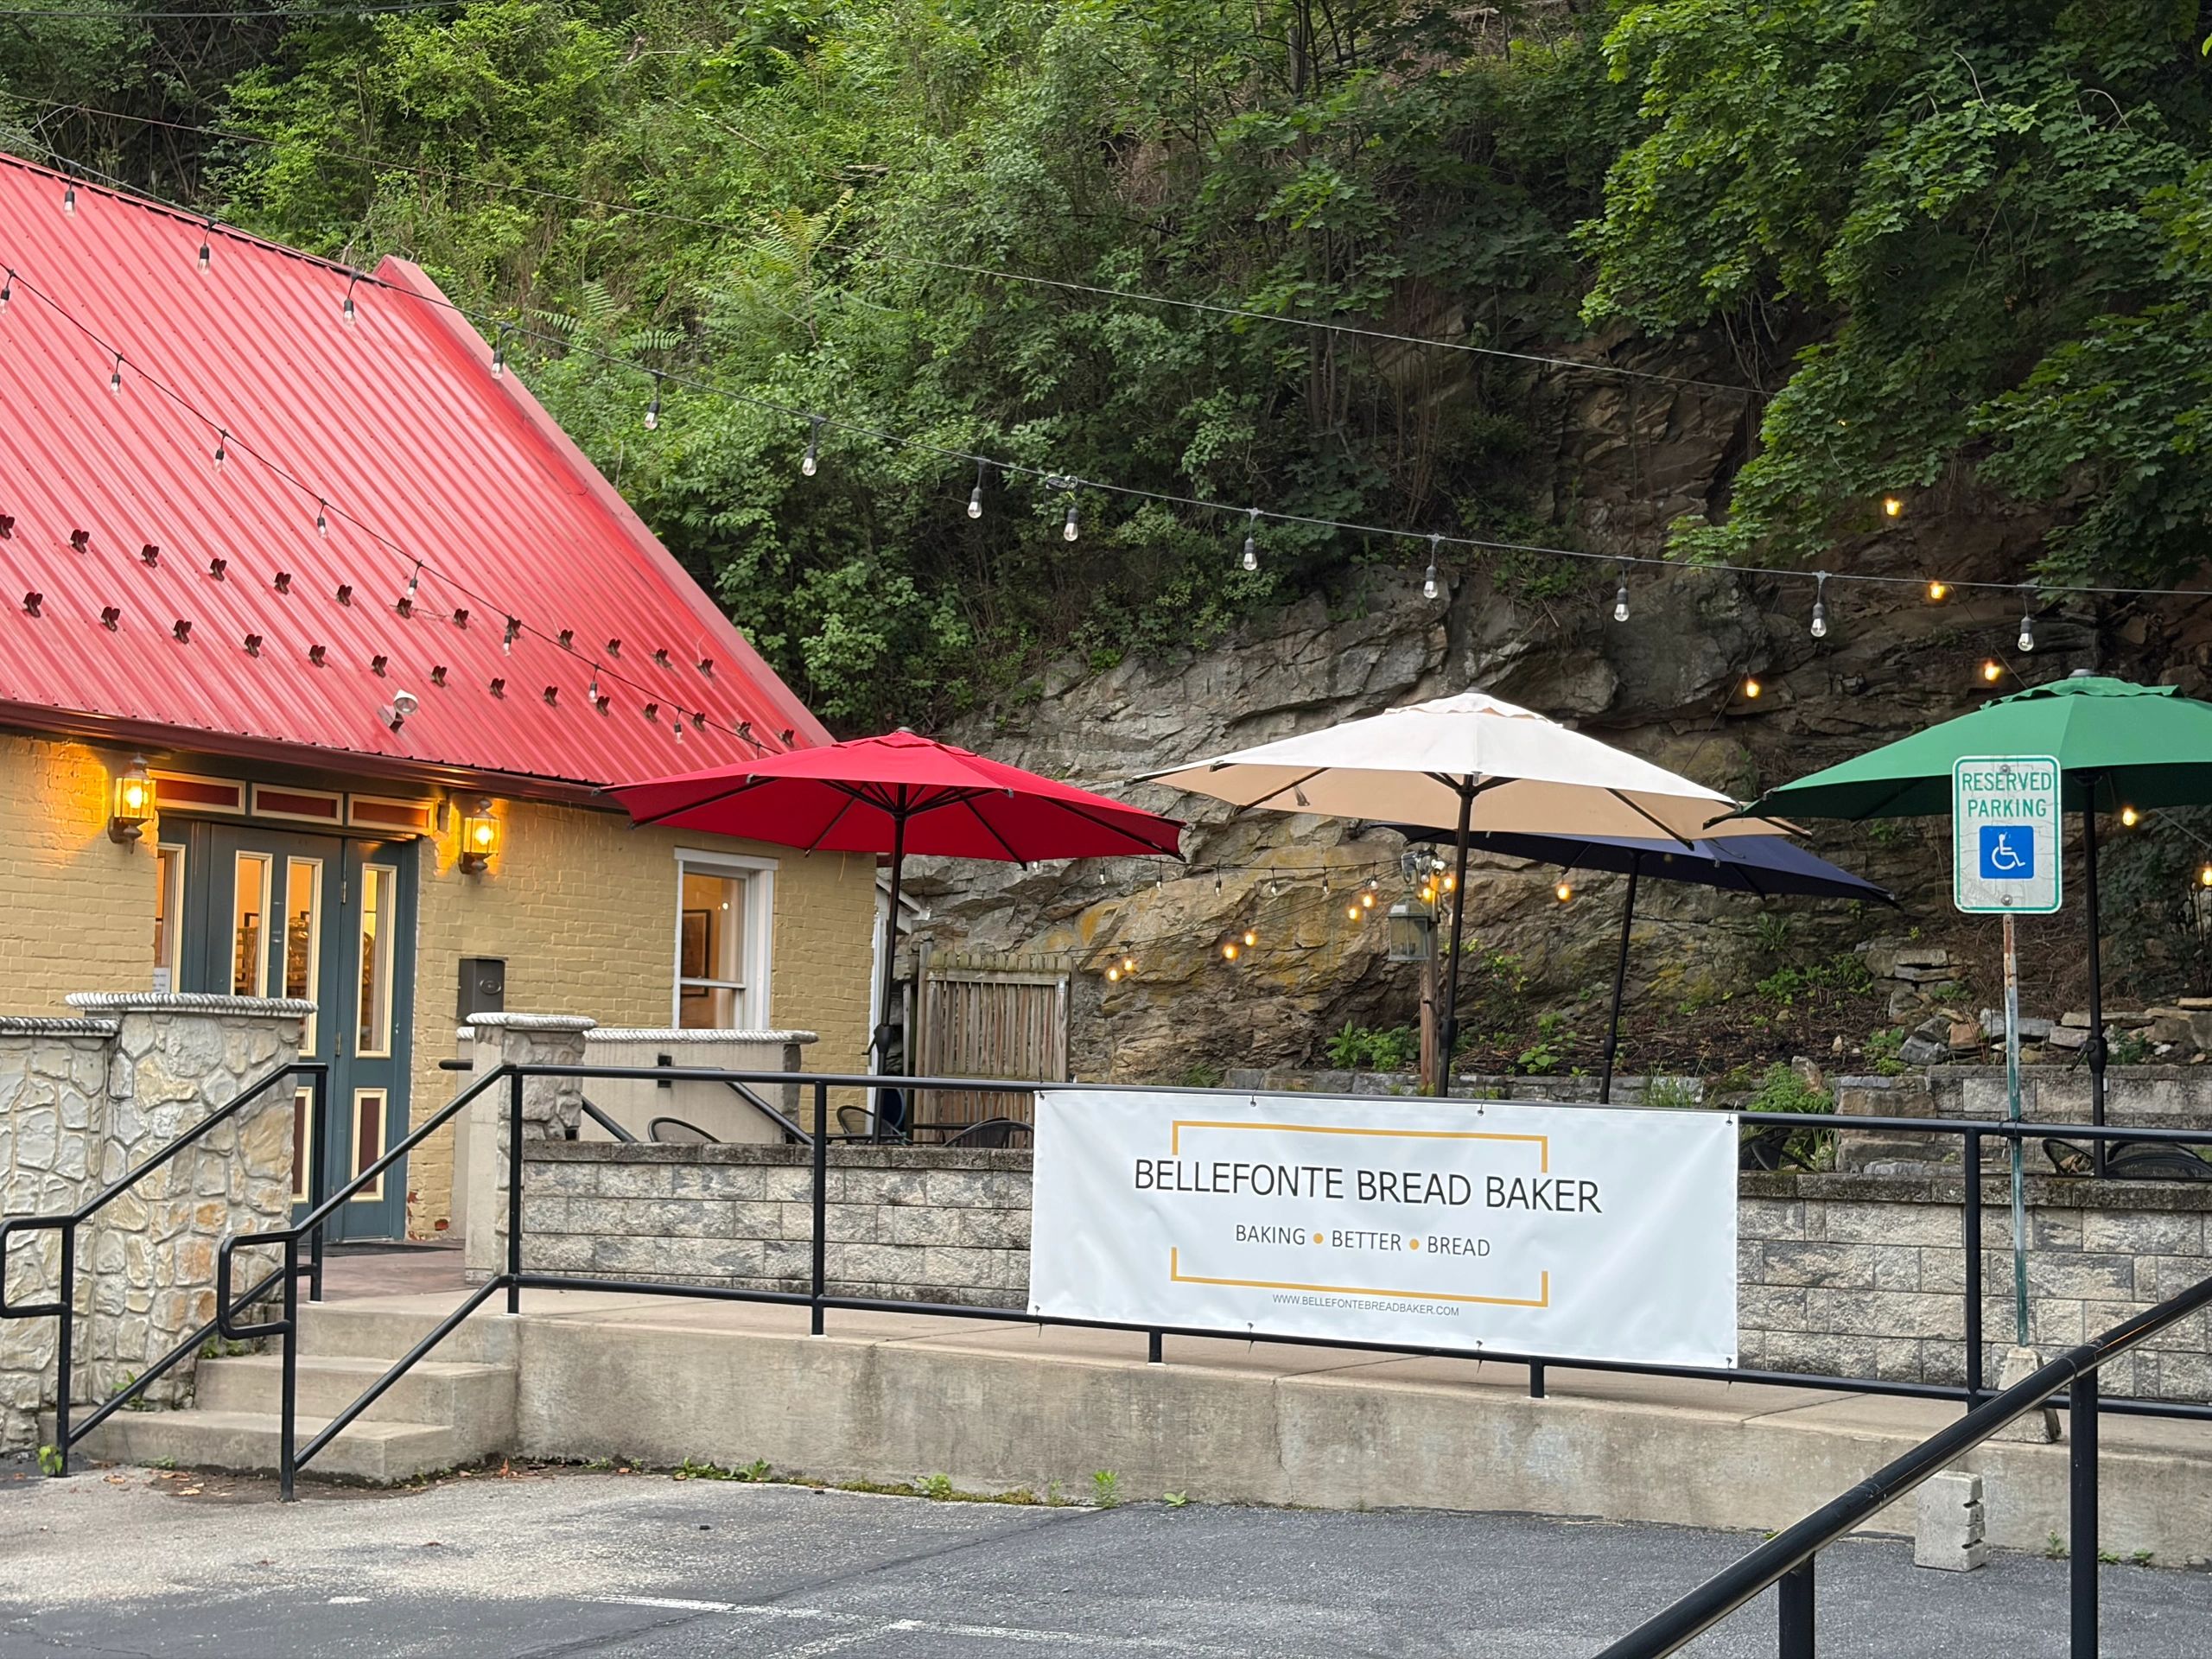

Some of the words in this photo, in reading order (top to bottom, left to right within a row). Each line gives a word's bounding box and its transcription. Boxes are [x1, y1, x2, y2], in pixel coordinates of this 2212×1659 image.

[1962, 772, 2052, 791] RESERVED
[1968, 799, 2047, 817] PARKING
[1135, 1159, 1344, 1199] BELLEFONTE
[1357, 1169, 1471, 1206] BREAD
[1485, 1175, 1604, 1214] BAKER
[1235, 1224, 1306, 1247] BAKING
[1331, 1229, 1402, 1252] BETTER
[1427, 1236, 1491, 1257] BREAD
[1272, 1294, 1460, 1317] WWW.BELLEFONTEBREADBAKER.COM
